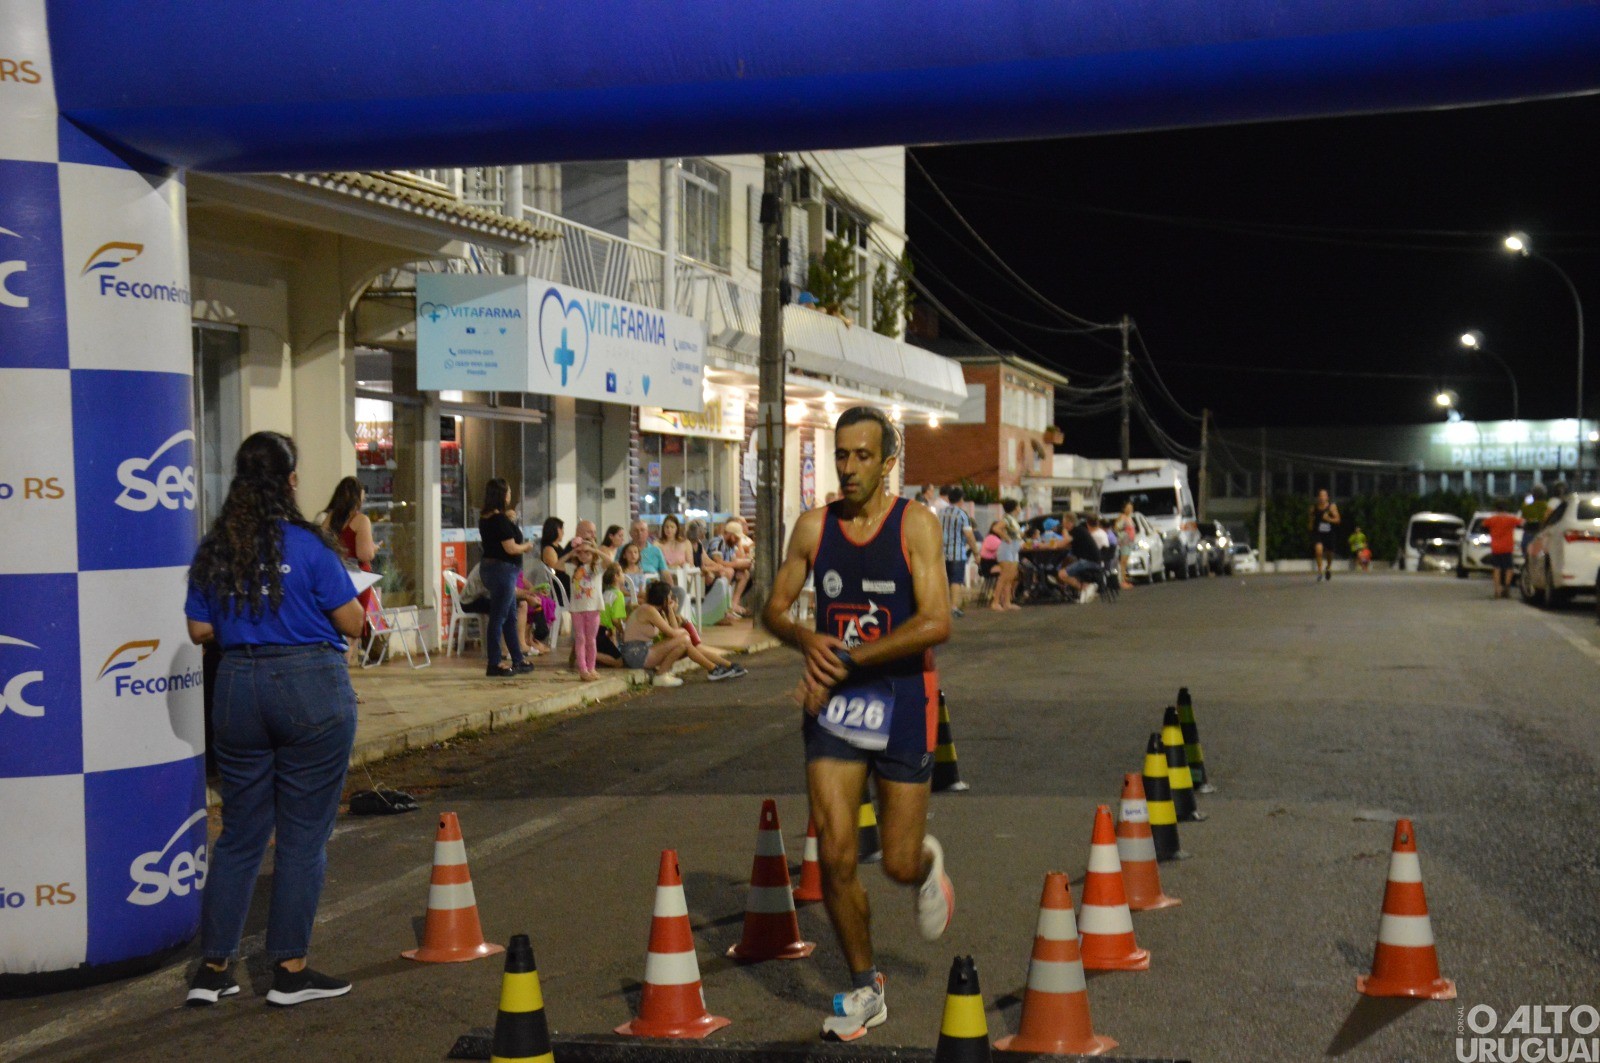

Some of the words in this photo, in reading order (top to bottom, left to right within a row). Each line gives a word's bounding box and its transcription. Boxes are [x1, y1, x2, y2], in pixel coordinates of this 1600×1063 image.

[0, 58, 42, 84] RS
[450, 305, 521, 319] VITAFARMA
[586, 298, 667, 347] VITAFARMA
[24, 477, 65, 500] RS
[826, 695, 885, 730] 026
[126, 844, 209, 906] Ses
[35, 882, 76, 907] RS
